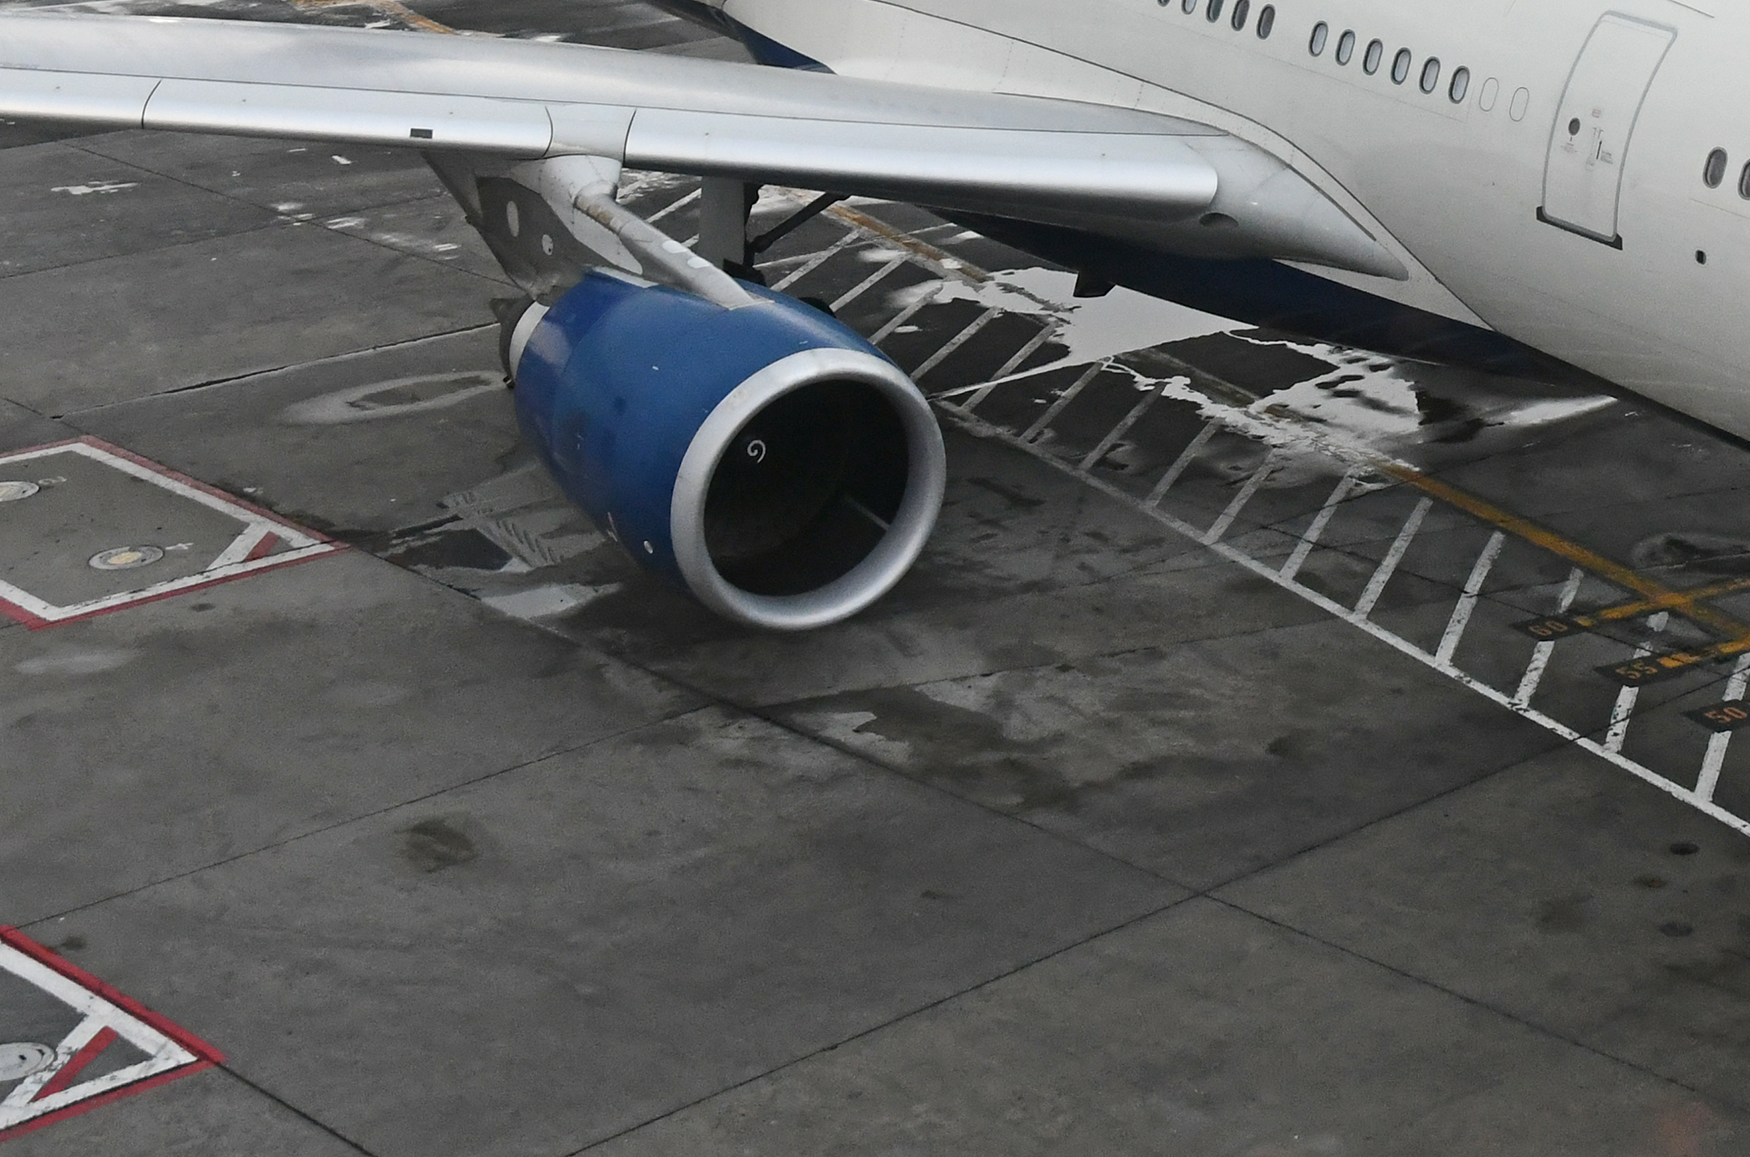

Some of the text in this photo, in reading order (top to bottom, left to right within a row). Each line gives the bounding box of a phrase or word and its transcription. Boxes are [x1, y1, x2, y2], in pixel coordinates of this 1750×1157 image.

[1527, 620, 1568, 637] 60
[1615, 661, 1658, 680] 55
[1702, 706, 1748, 723] 50
